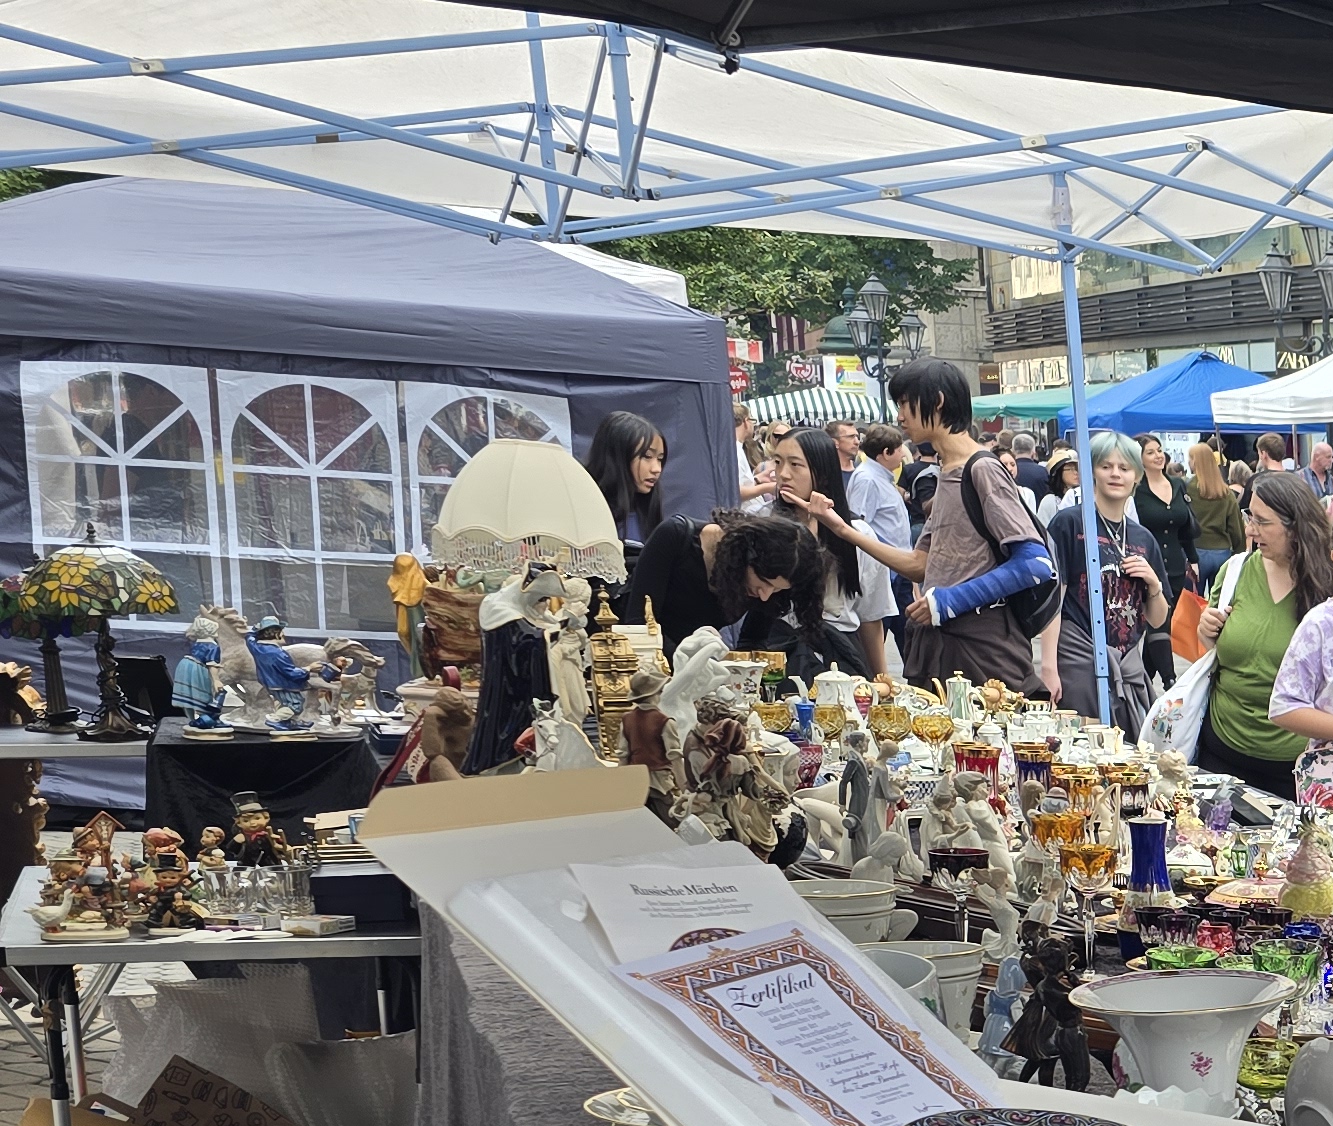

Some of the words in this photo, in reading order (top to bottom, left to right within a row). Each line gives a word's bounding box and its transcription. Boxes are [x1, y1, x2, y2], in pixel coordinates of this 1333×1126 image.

[629, 884, 685, 896] Russische
[683, 883, 738, 896] Märchen
[726, 972, 817, 1011] Zertifikat
